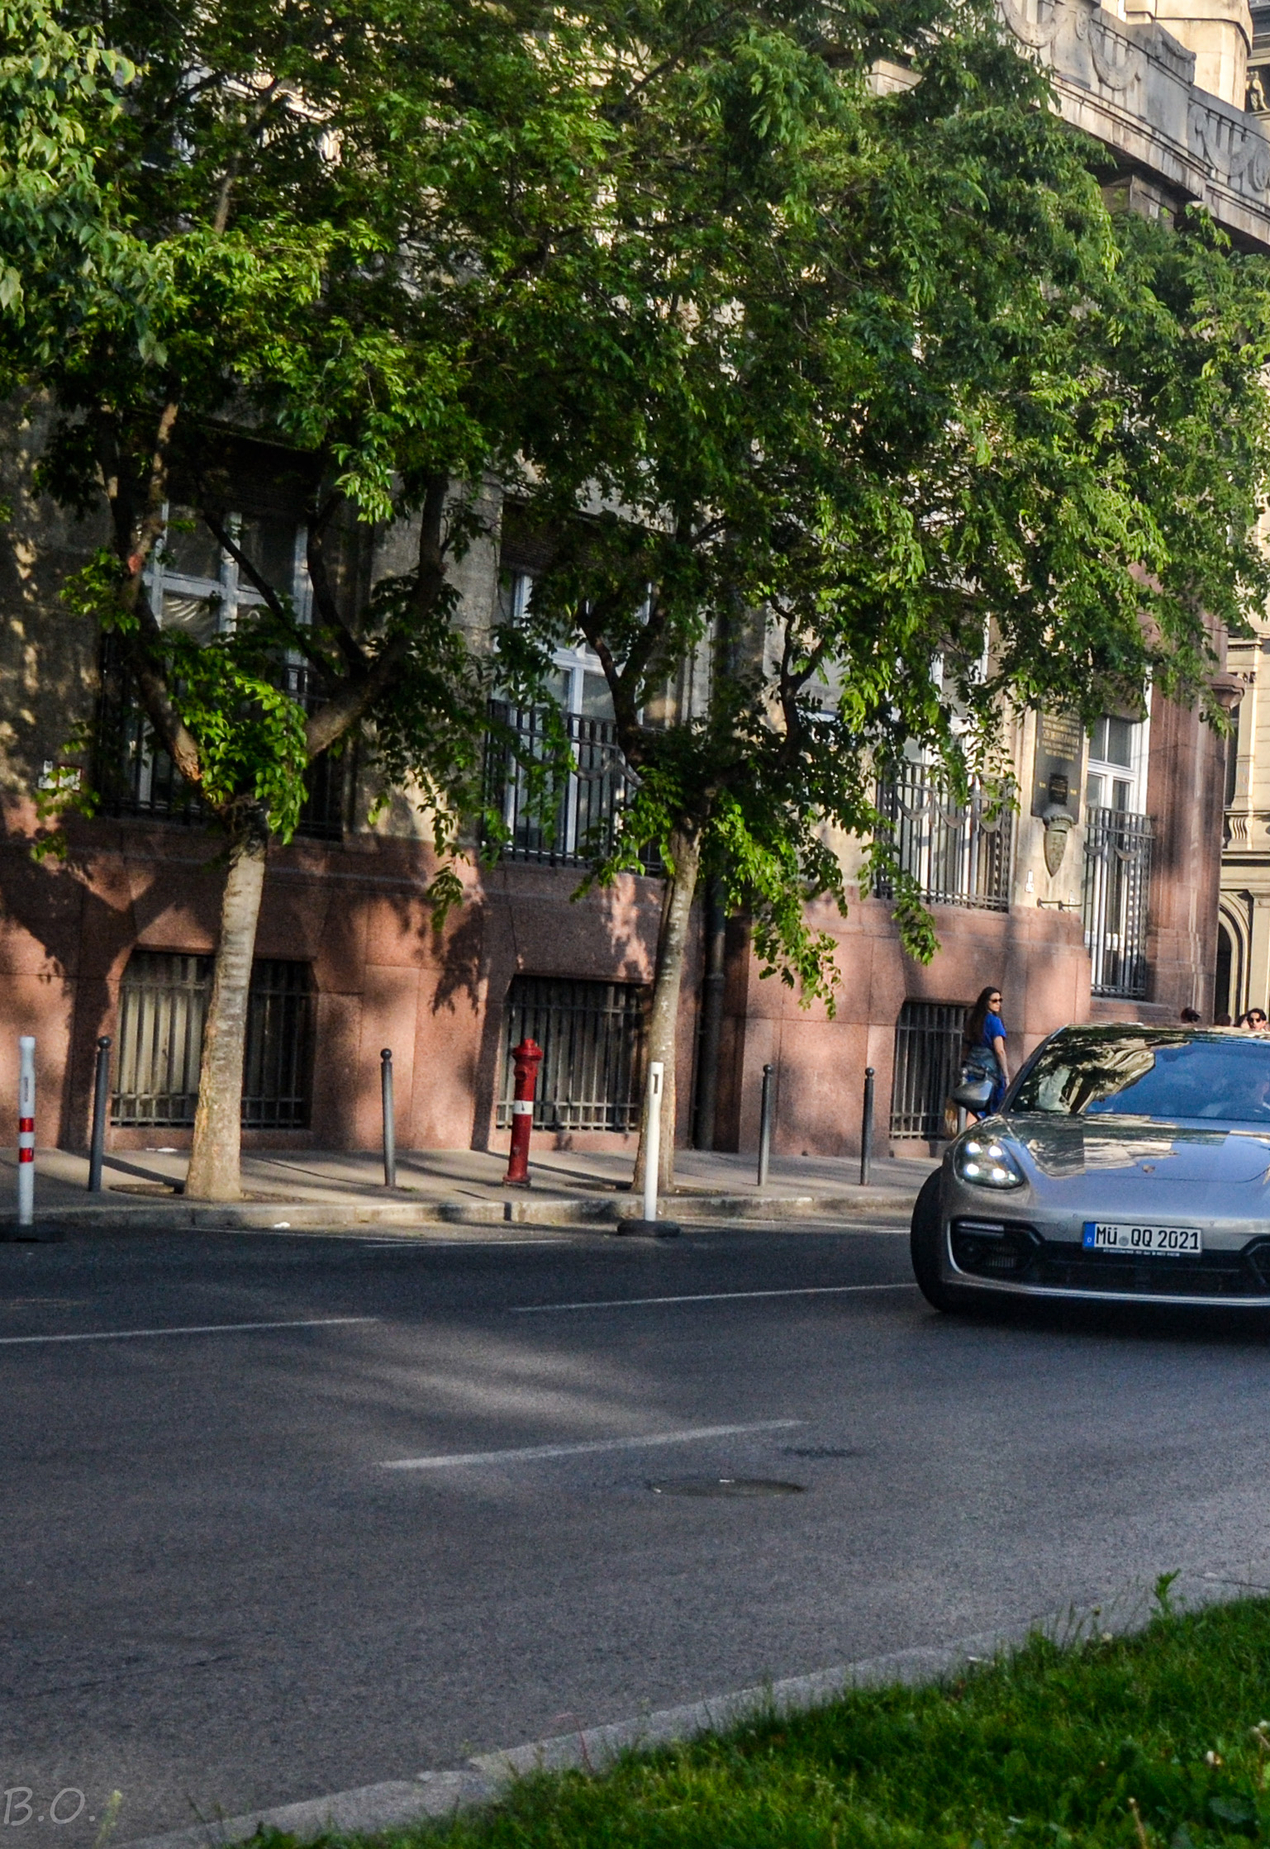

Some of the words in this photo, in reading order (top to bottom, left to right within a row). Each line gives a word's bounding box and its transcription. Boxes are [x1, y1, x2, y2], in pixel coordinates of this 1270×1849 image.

[1096, 1226, 1118, 1245] MÜ
[1131, 1228, 1153, 1248] QQ
[1157, 1230, 1199, 1250] 2021
